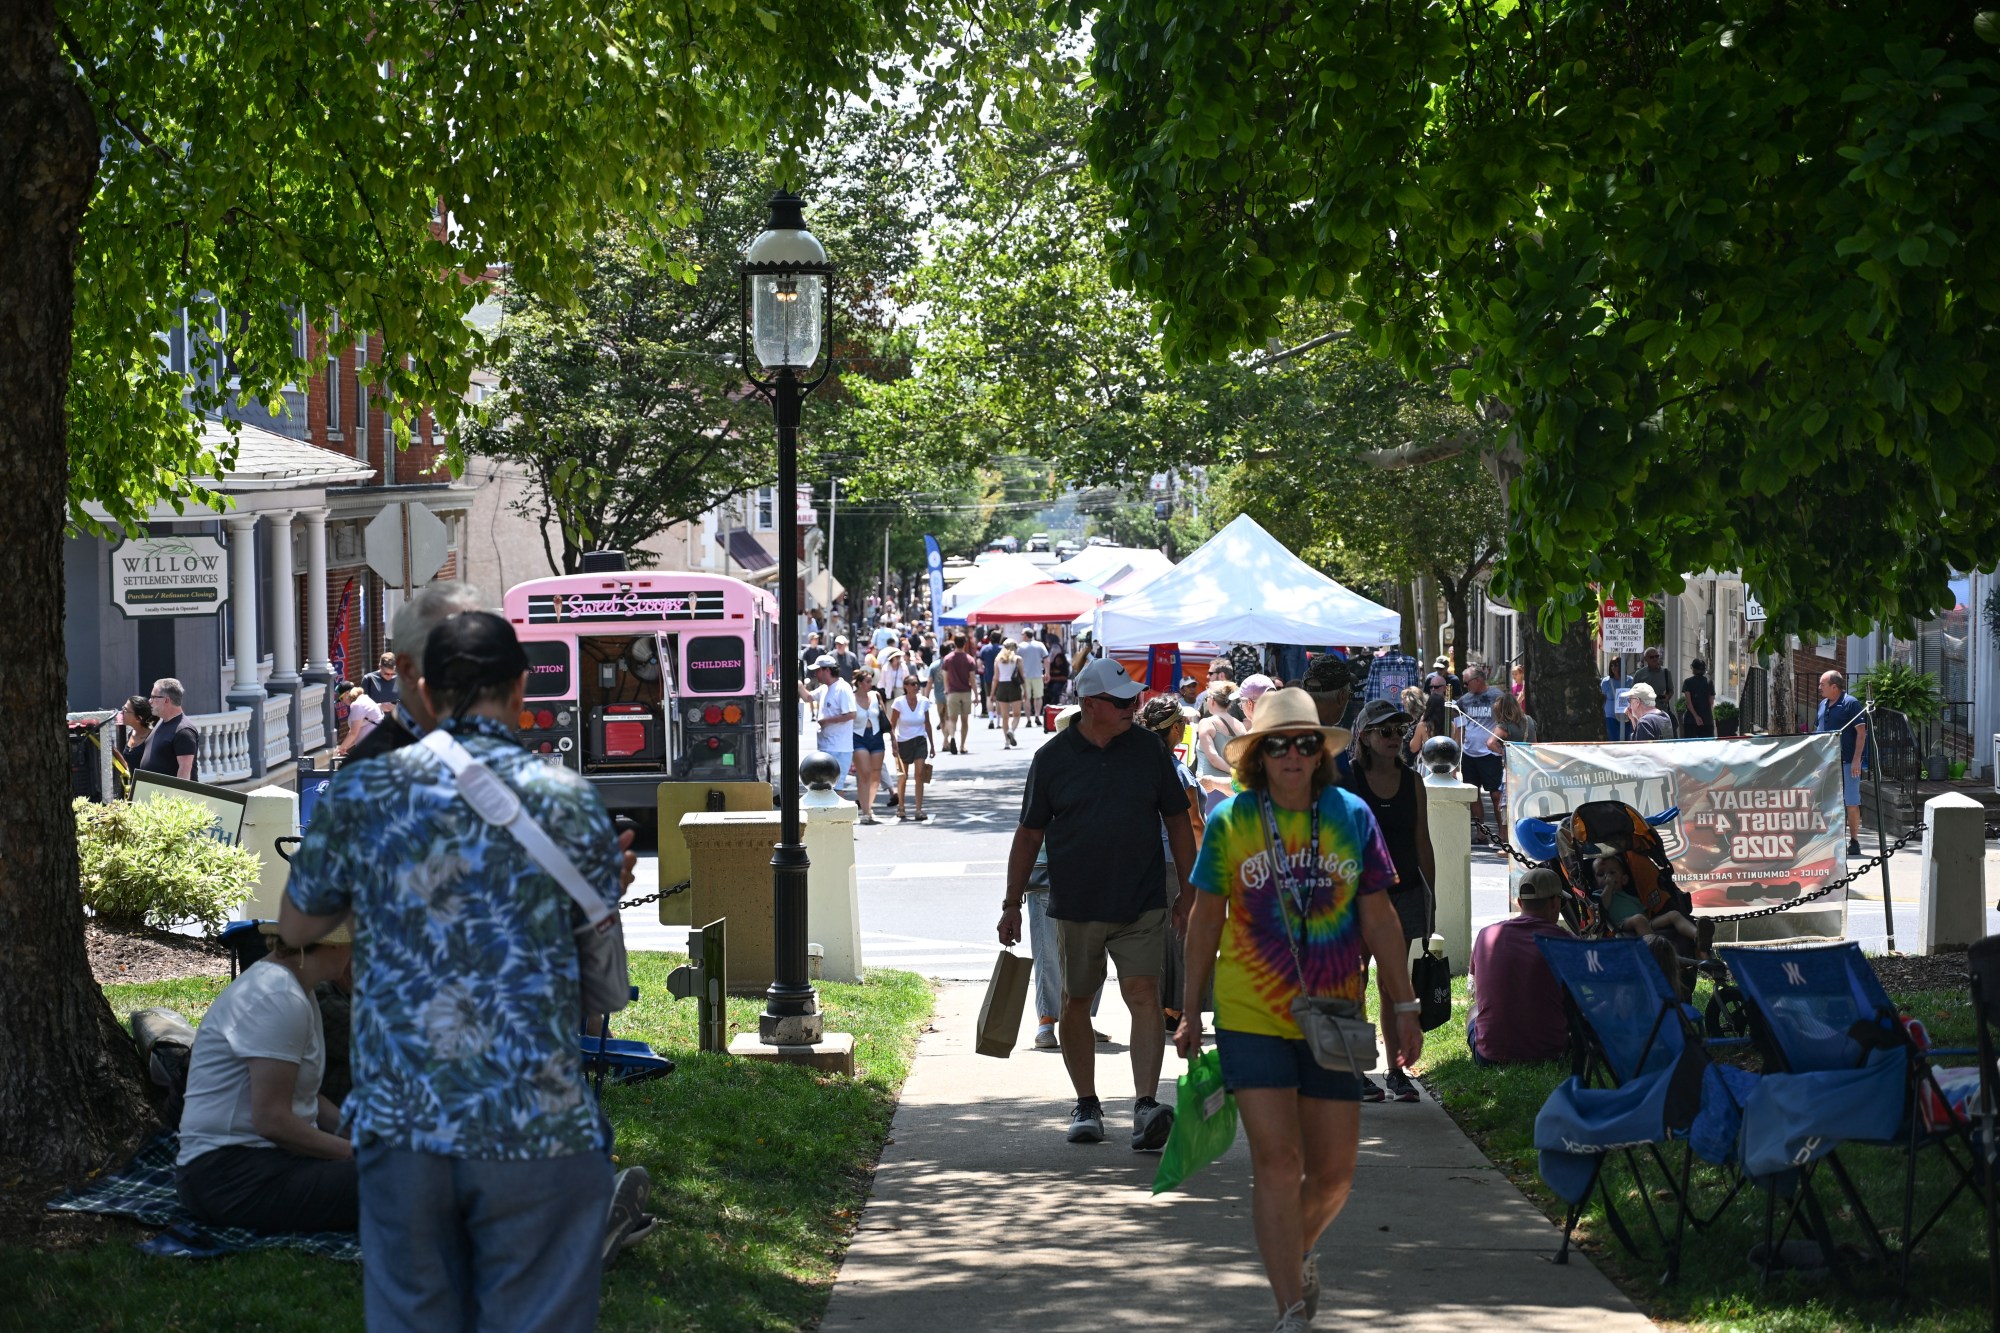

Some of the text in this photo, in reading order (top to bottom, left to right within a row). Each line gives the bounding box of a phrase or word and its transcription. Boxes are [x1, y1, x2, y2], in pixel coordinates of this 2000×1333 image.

[122, 555, 219, 572] WILLOW
[123, 574, 218, 586] SETTLEMENT SERVICES
[127, 592, 154, 600] Purchase
[190, 591, 216, 599] Closings
[568, 593, 685, 620] Sweet Scoops
[529, 664, 564, 674] UTION
[690, 659, 742, 669] CHILDREN
[1467, 706, 1492, 717] JAMAICA
[1305, 877, 1333, 888] 133
